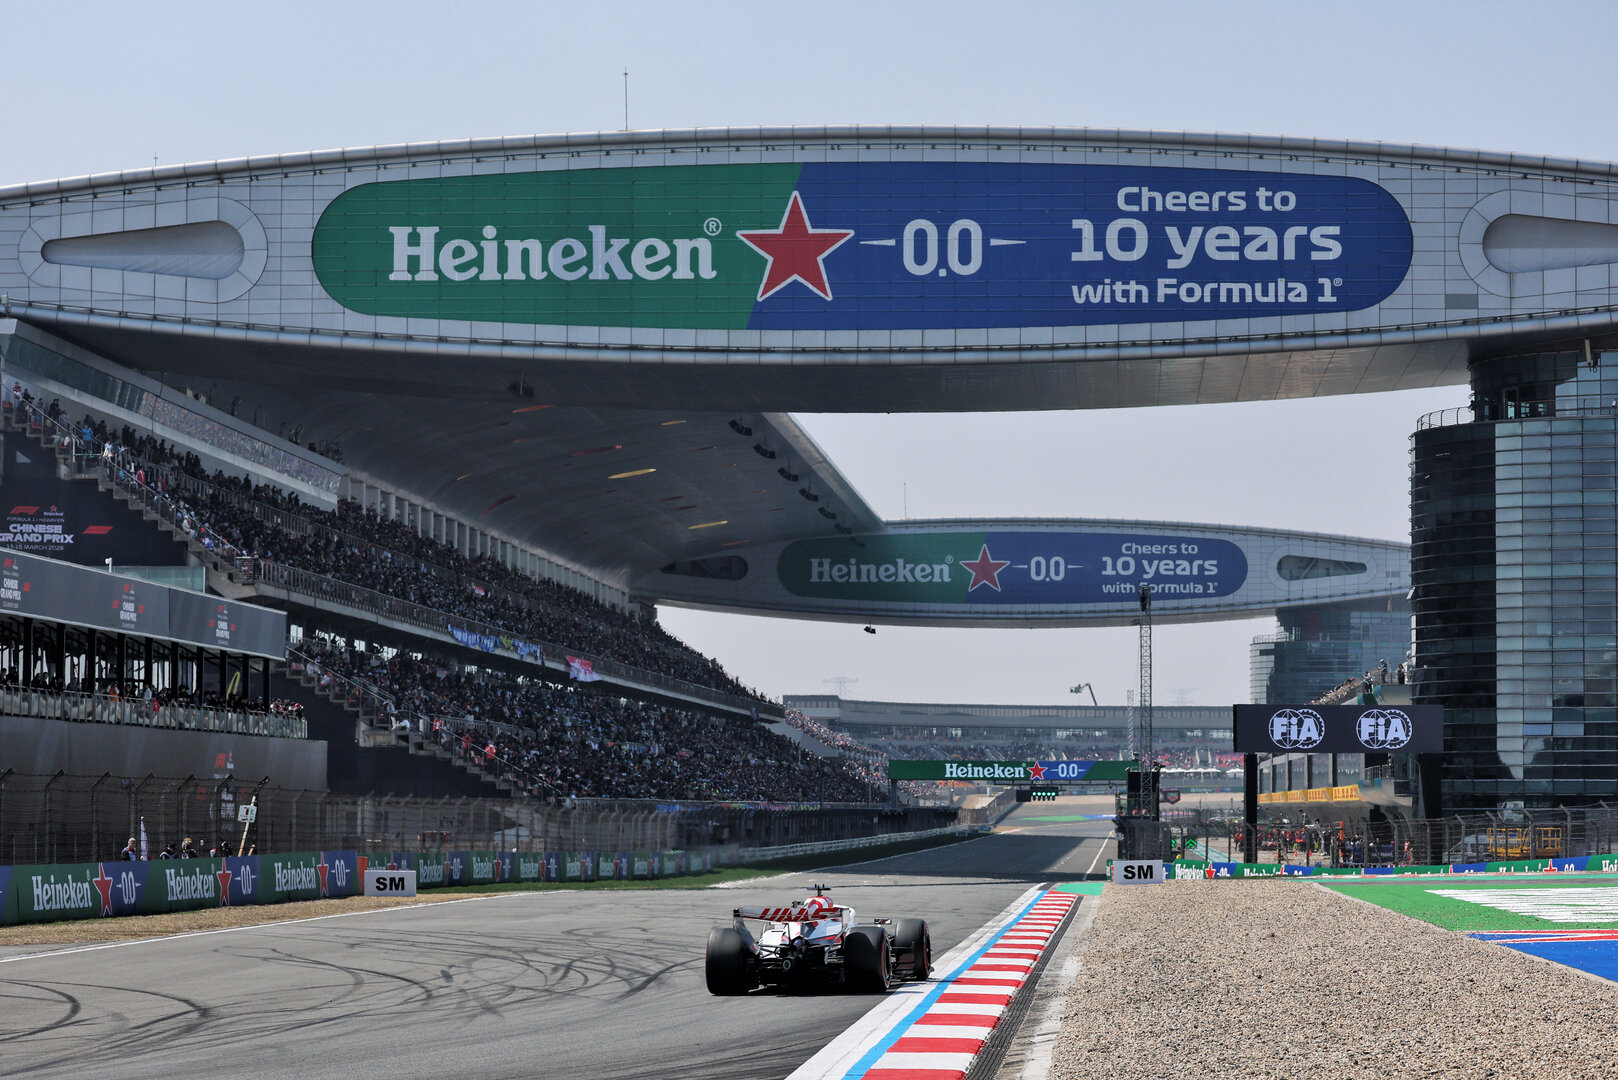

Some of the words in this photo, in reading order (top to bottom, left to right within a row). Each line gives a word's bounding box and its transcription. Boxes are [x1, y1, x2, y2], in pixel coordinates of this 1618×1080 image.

[1117, 186, 1247, 212] Cheers
[1257, 187, 1297, 212] to
[903, 218, 983, 277] 0.0
[1071, 218, 1149, 262] 10
[1167, 224, 1342, 270] years
[1072, 278, 1151, 304] with
[1156, 278, 1309, 303] Formula
[9, 523, 63, 534] CHINESE
[0, 532, 42, 543] GRAND
[43, 533, 75, 544] PRIX
[1121, 543, 1178, 555] Cheers
[1181, 543, 1199, 555] to
[1030, 556, 1066, 582] 0.0
[1102, 556, 1136, 576] 10
[1141, 559, 1218, 579] years
[1102, 582, 1136, 594] with
[1058, 763, 1079, 778] 0.0
[1123, 864, 1154, 880] SM
[375, 876, 405, 891] SM
[758, 907, 840, 922] HAAS
